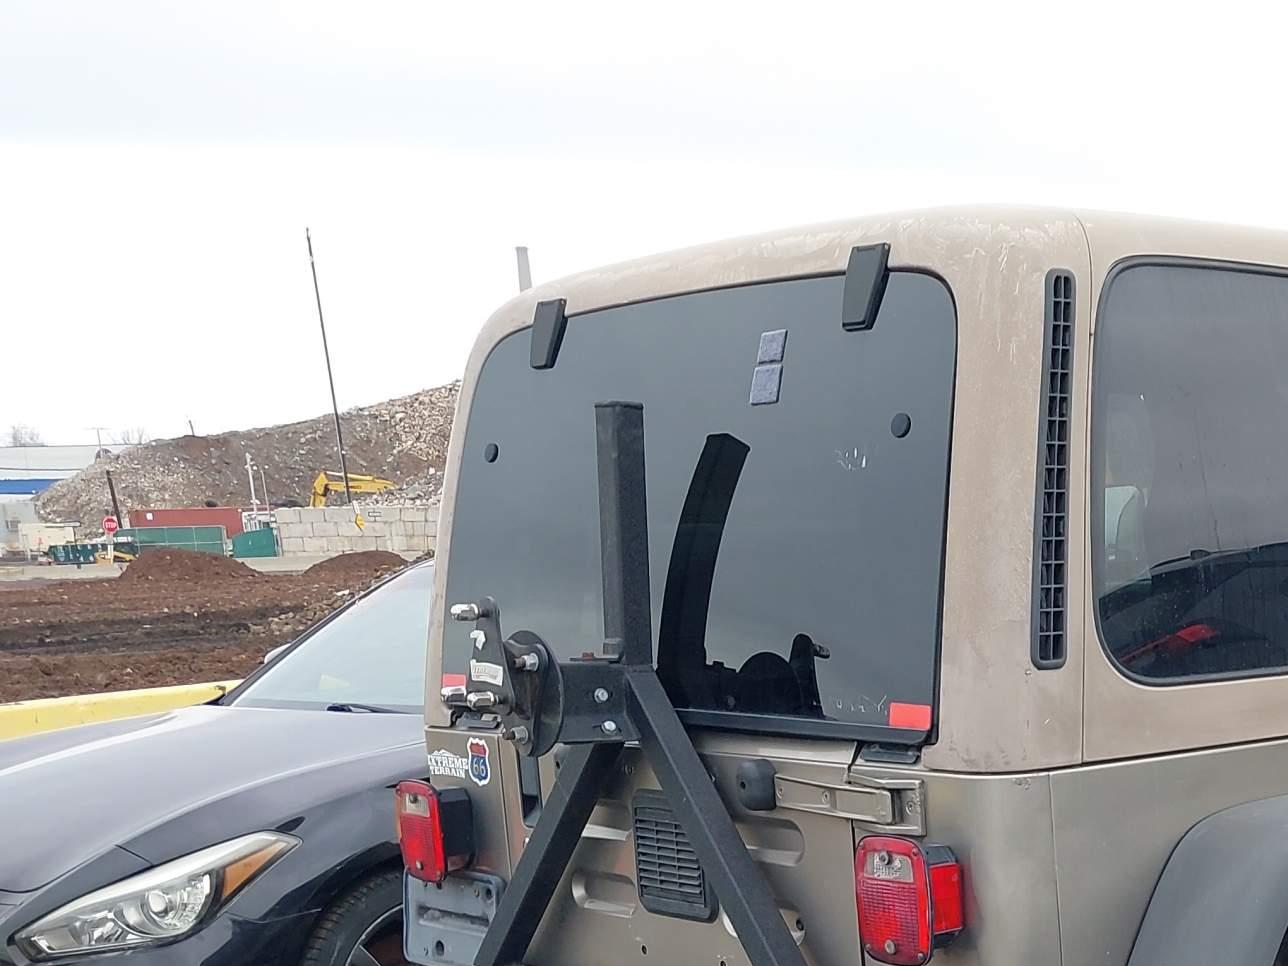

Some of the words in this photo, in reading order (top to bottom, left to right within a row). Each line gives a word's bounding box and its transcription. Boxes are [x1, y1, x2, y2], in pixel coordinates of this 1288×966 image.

[105, 521, 117, 529] STOP
[430, 765, 466, 779] TERRAIN
[473, 757, 486, 777] 66
